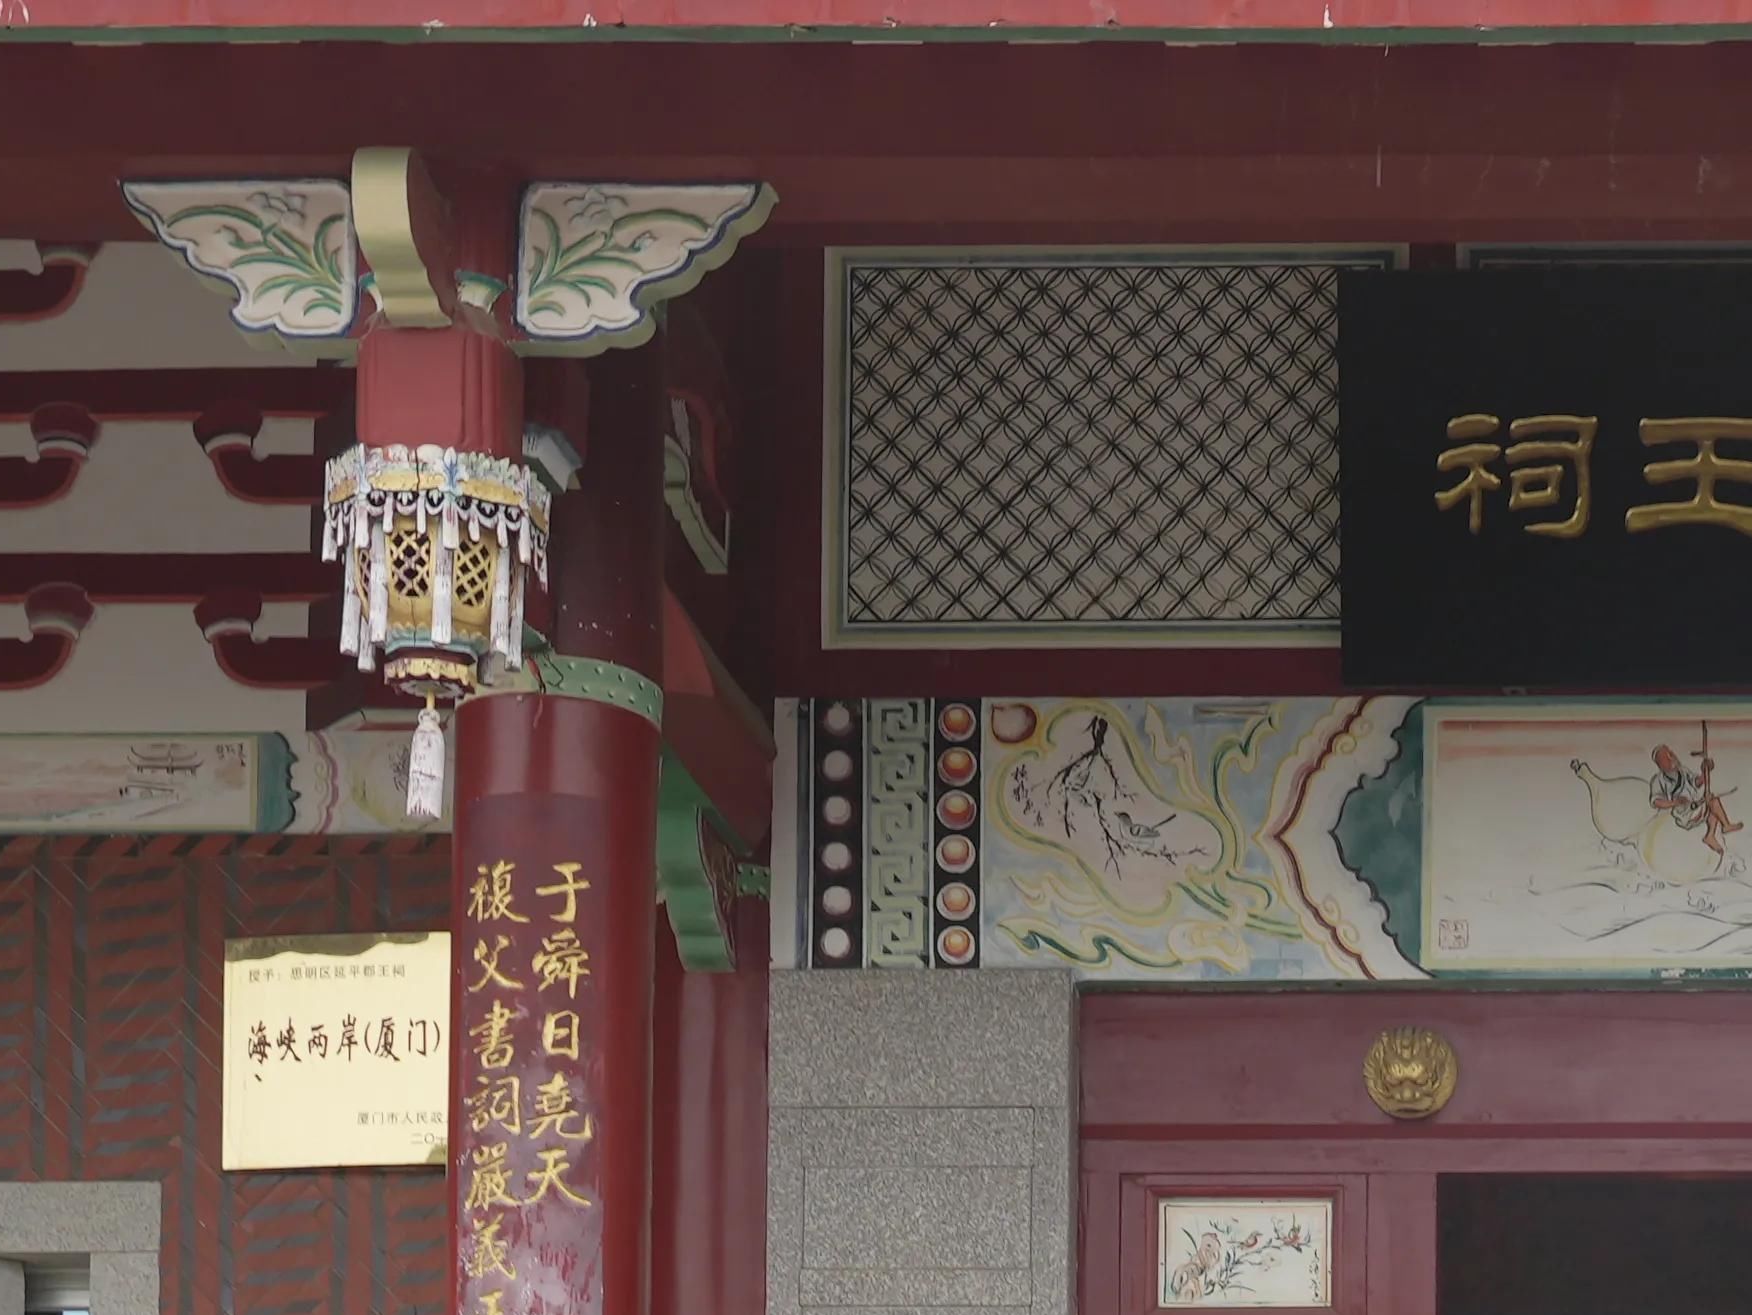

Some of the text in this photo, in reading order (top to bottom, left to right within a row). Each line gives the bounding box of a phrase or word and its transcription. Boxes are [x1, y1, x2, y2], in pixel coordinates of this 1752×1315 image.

[357, 1110, 447, 1125] 厦门市人民政
